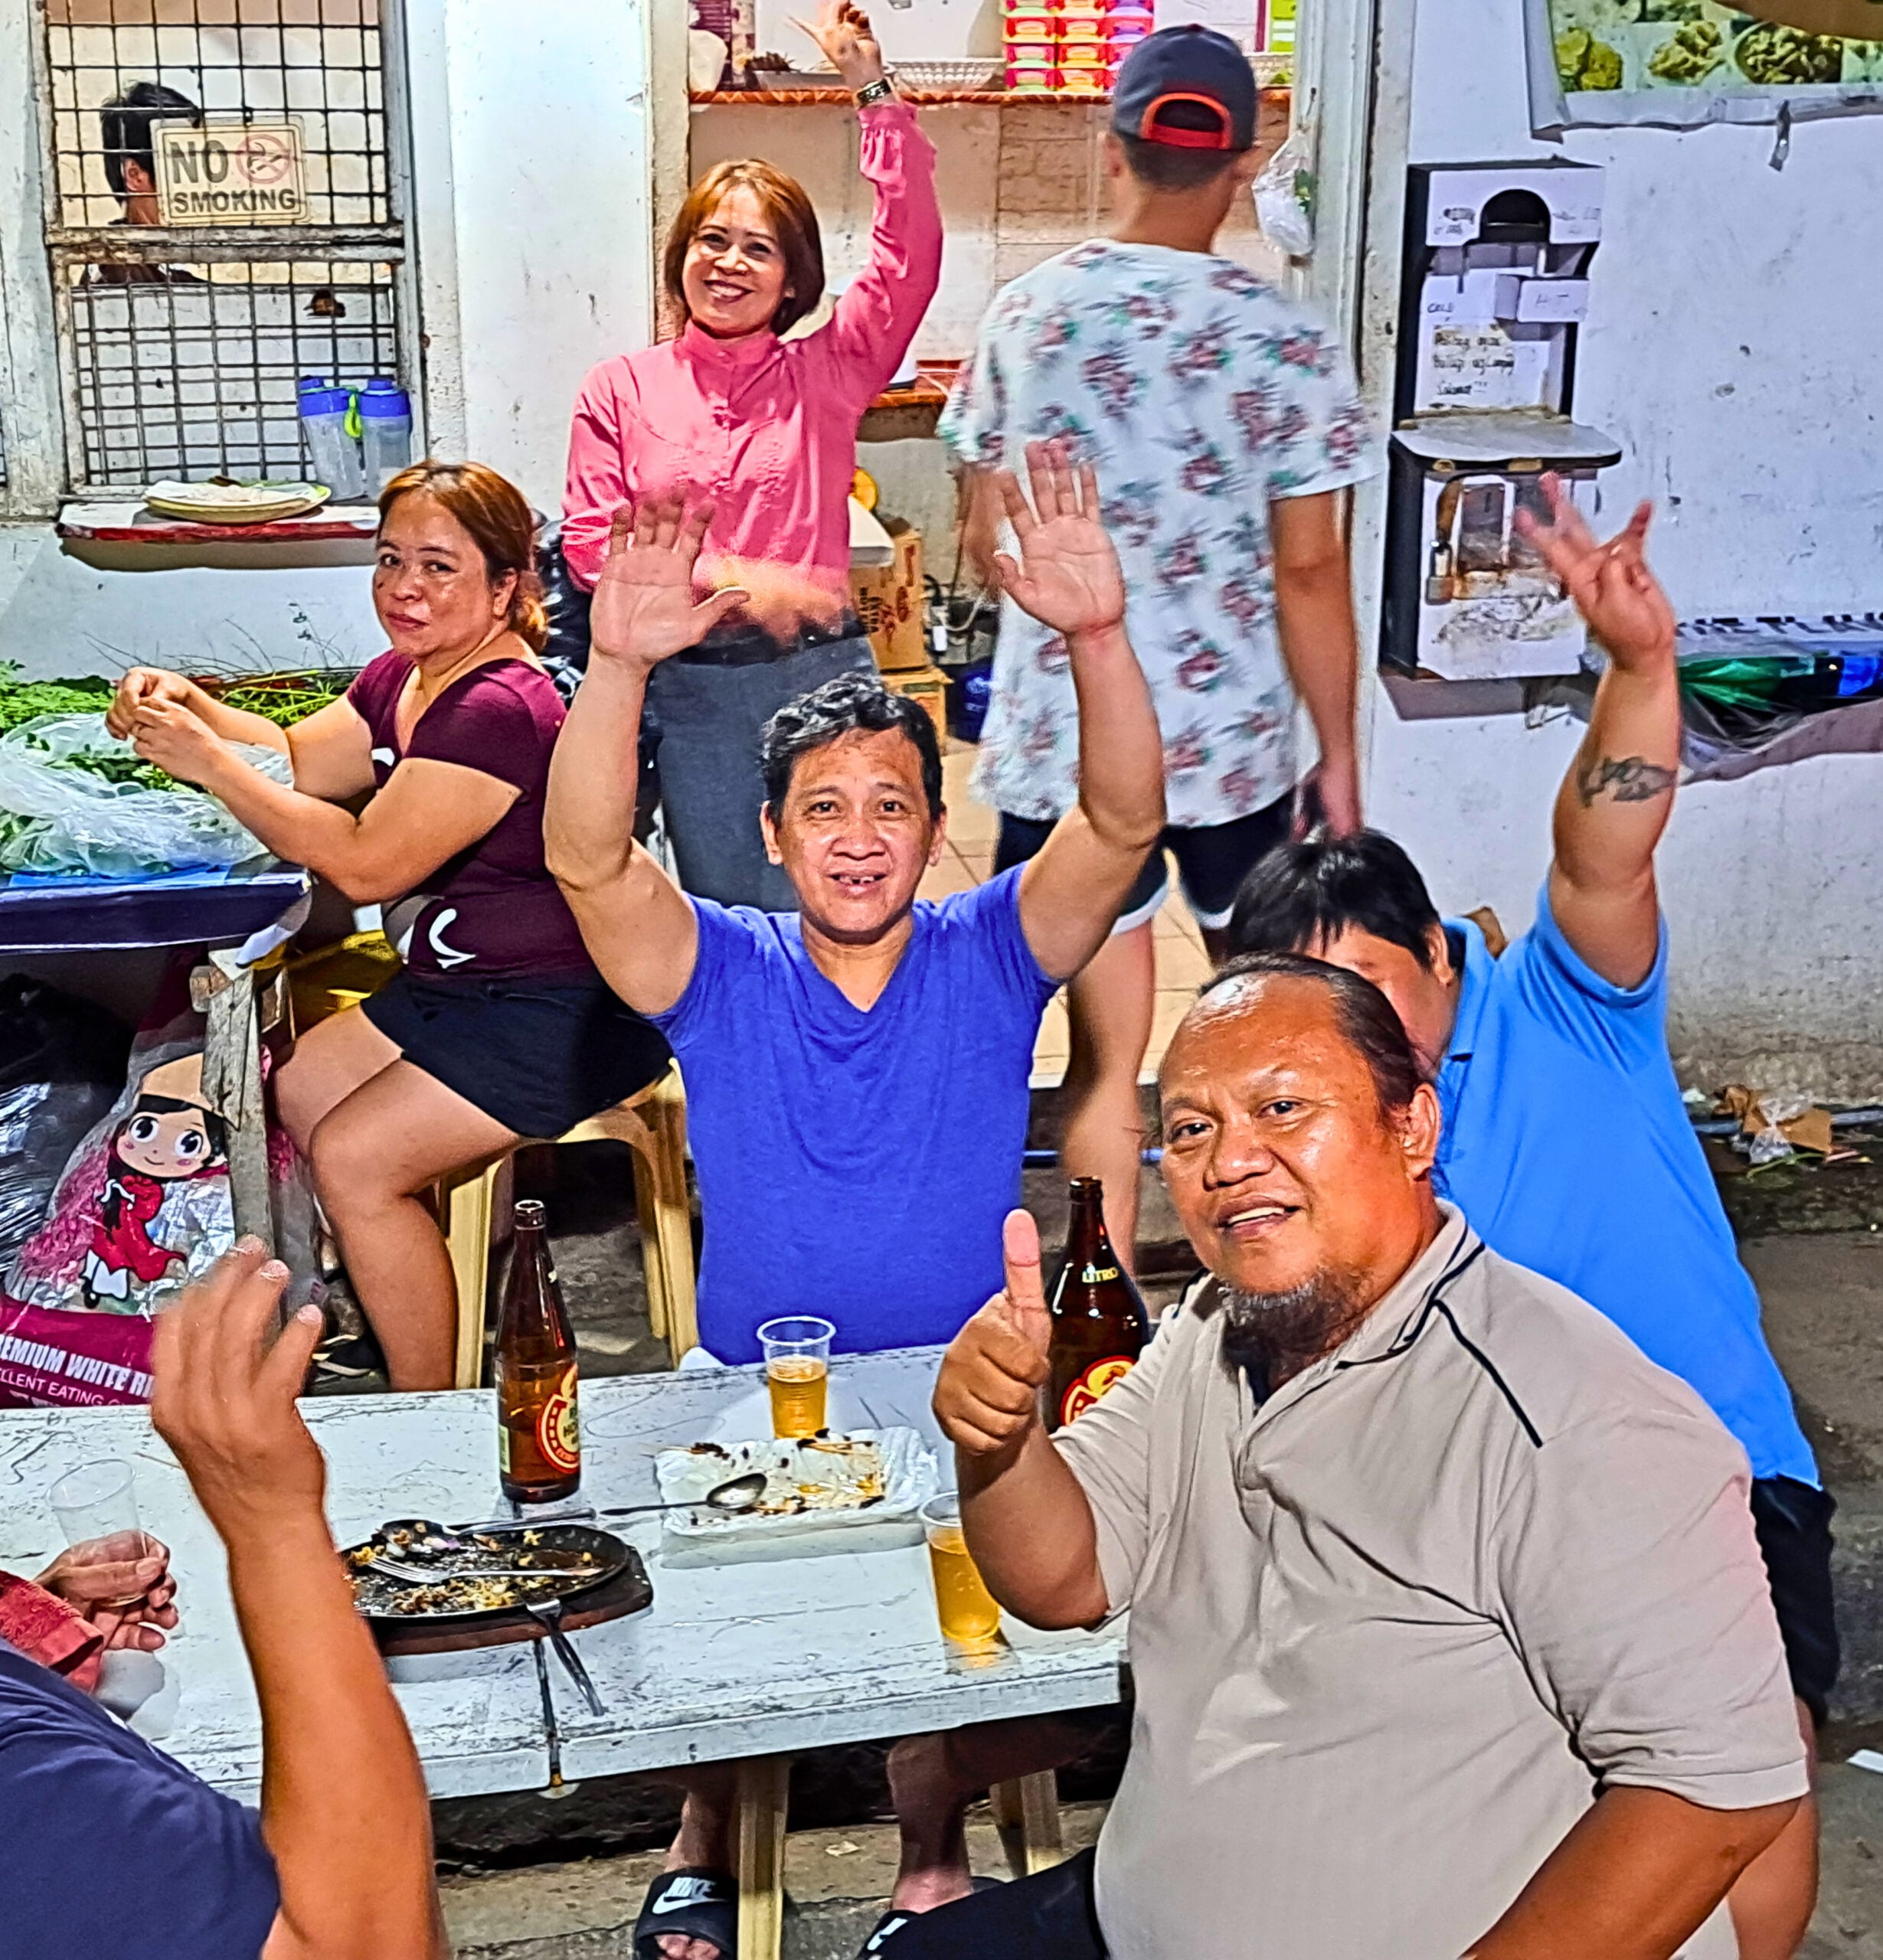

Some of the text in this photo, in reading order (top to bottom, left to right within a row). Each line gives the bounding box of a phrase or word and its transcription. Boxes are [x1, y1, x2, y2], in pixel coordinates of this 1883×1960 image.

[169, 139, 229, 185] NO
[173, 188, 296, 214] SMOKING
[1081, 1266, 1120, 1284] LITRO
[64, 1353, 132, 1391] WHITE
[128, 1370, 155, 1398] RI
[47, 1381, 106, 1406] EATING
[664, 1877, 718, 1899] NIKE
